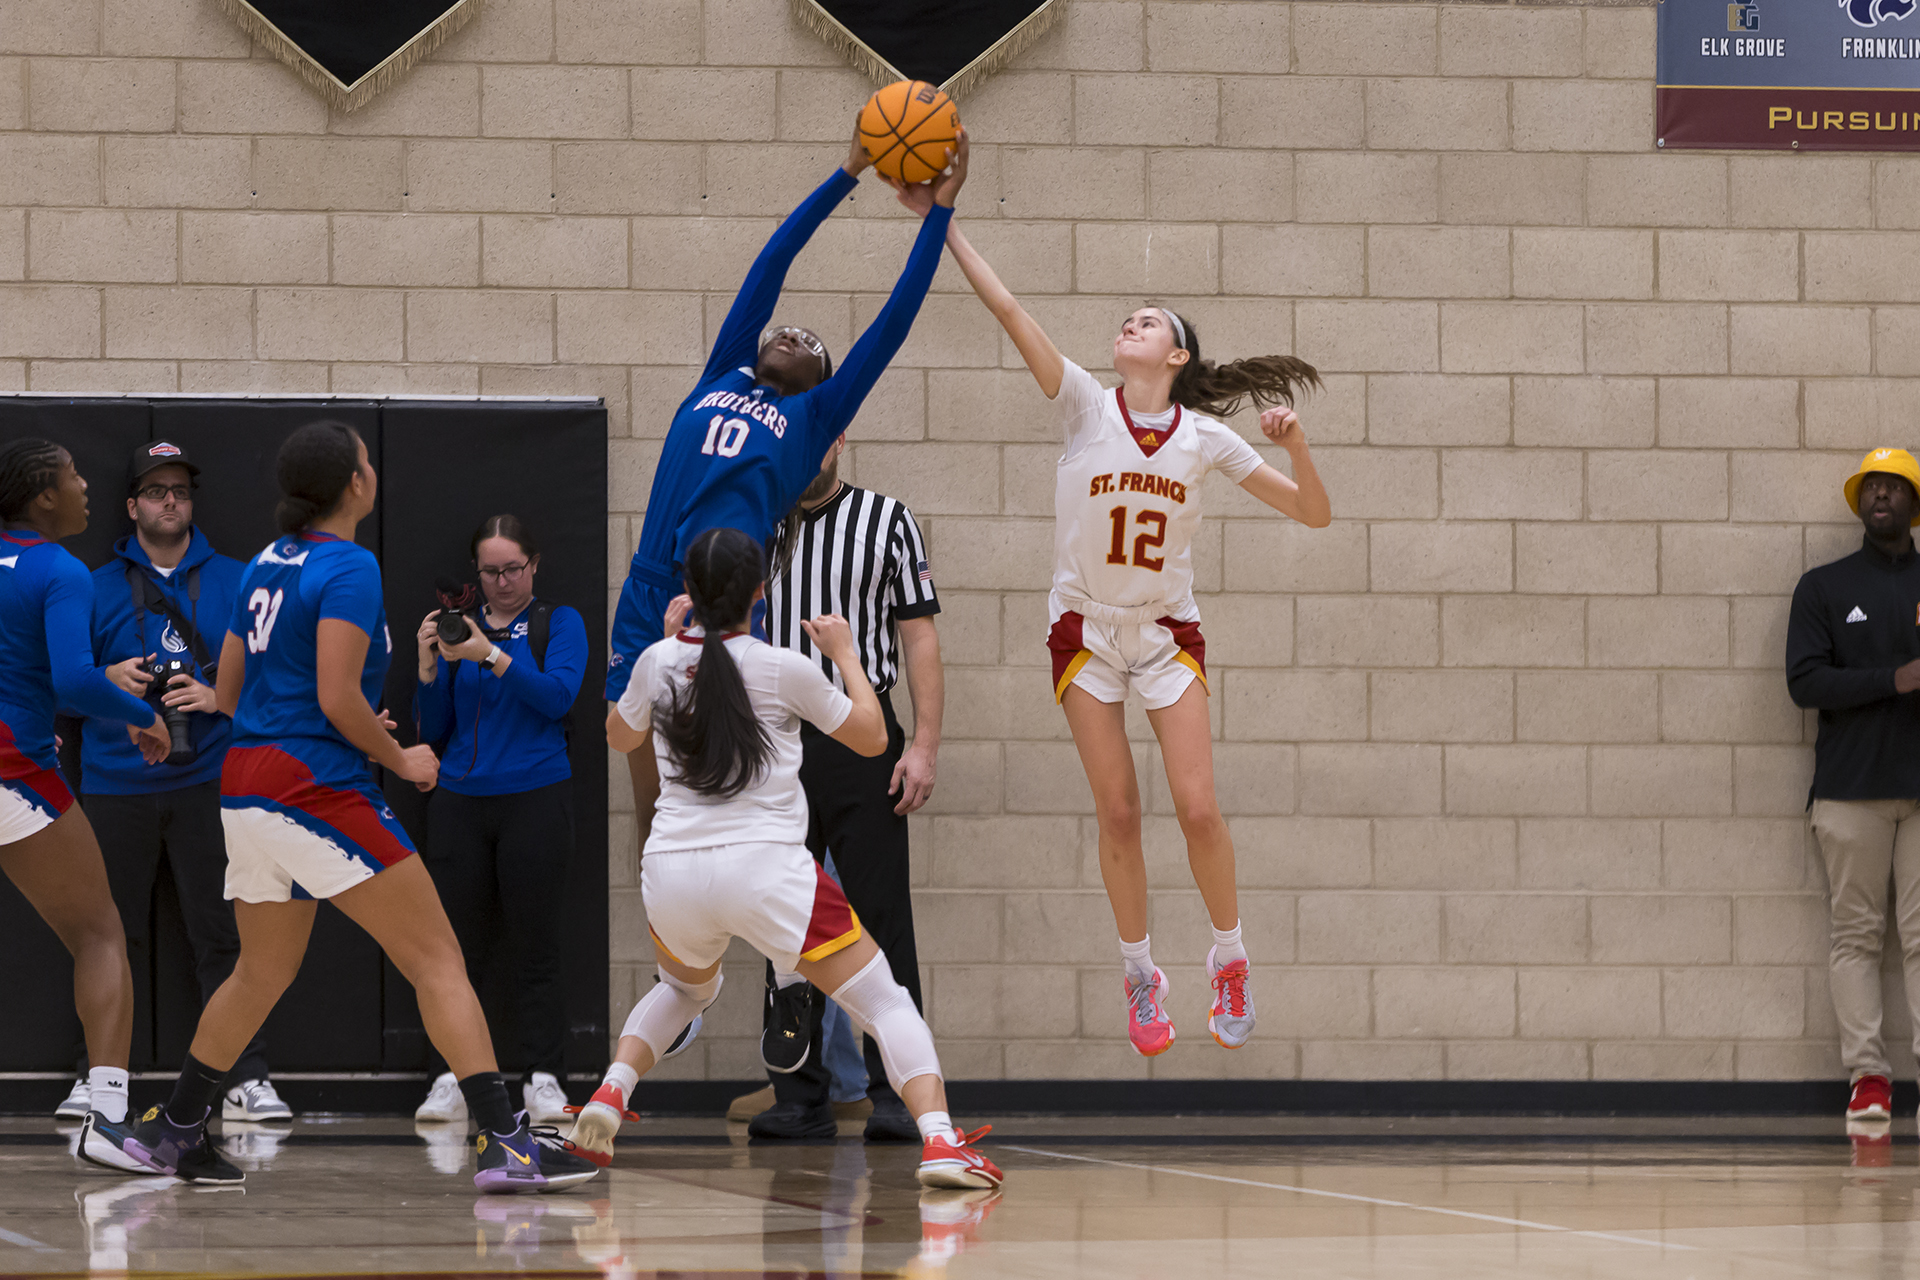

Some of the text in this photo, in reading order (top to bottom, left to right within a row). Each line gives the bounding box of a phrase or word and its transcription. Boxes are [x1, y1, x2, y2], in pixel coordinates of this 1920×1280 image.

[1701, 37, 1785, 57] ELK GROVE
[701, 414, 750, 458] 10
[1089, 472, 1115, 497] ST.
[1106, 505, 1167, 572] 12
